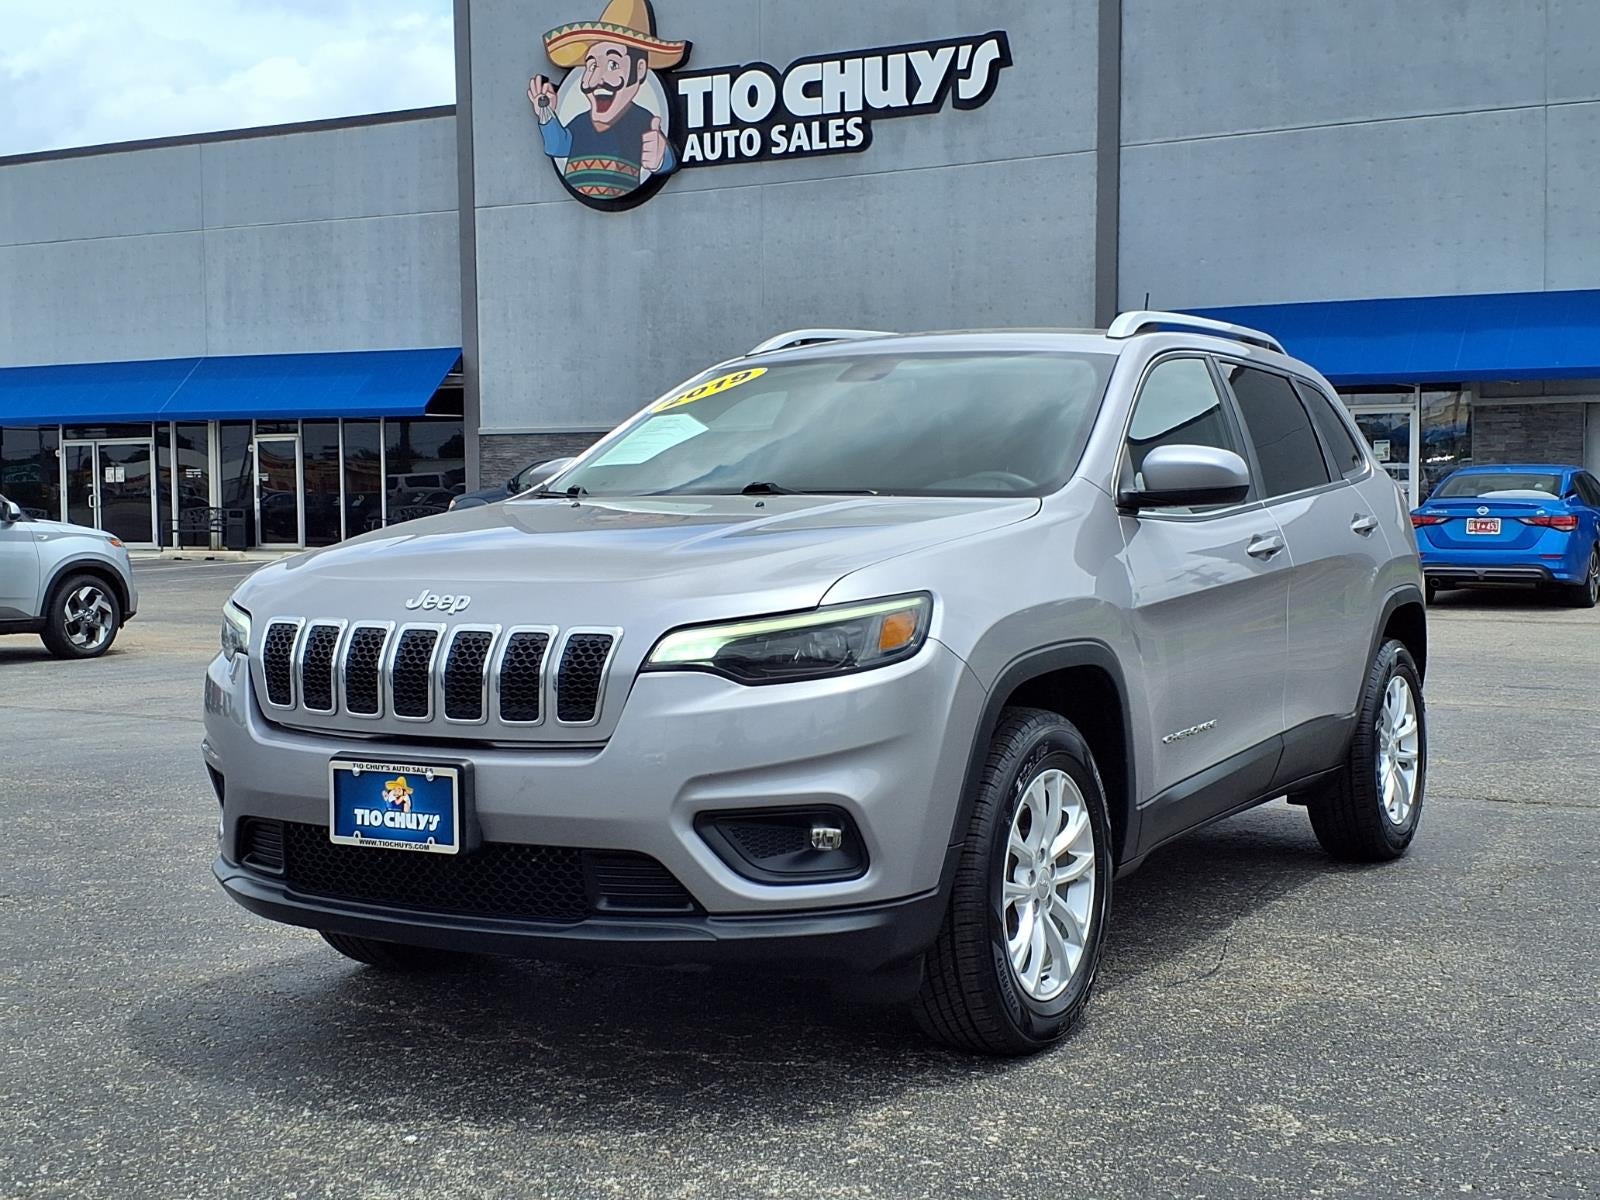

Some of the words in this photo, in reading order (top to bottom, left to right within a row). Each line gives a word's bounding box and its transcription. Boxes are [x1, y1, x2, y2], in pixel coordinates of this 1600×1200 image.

[678, 70, 776, 128] TIO
[782, 39, 1001, 117] CHUY'S
[681, 127, 762, 162] AUTO
[770, 116, 864, 154] SALES
[405, 588, 471, 616] Jeep
[366, 763, 391, 771] CHUY'S
[392, 765, 411, 773] AUTO
[412, 766, 434, 774] SALES
[354, 808, 383, 827] TIO
[384, 811, 440, 831] CHUY'S
[358, 839, 430, 850] WWW.TIOCHUYS.COM
